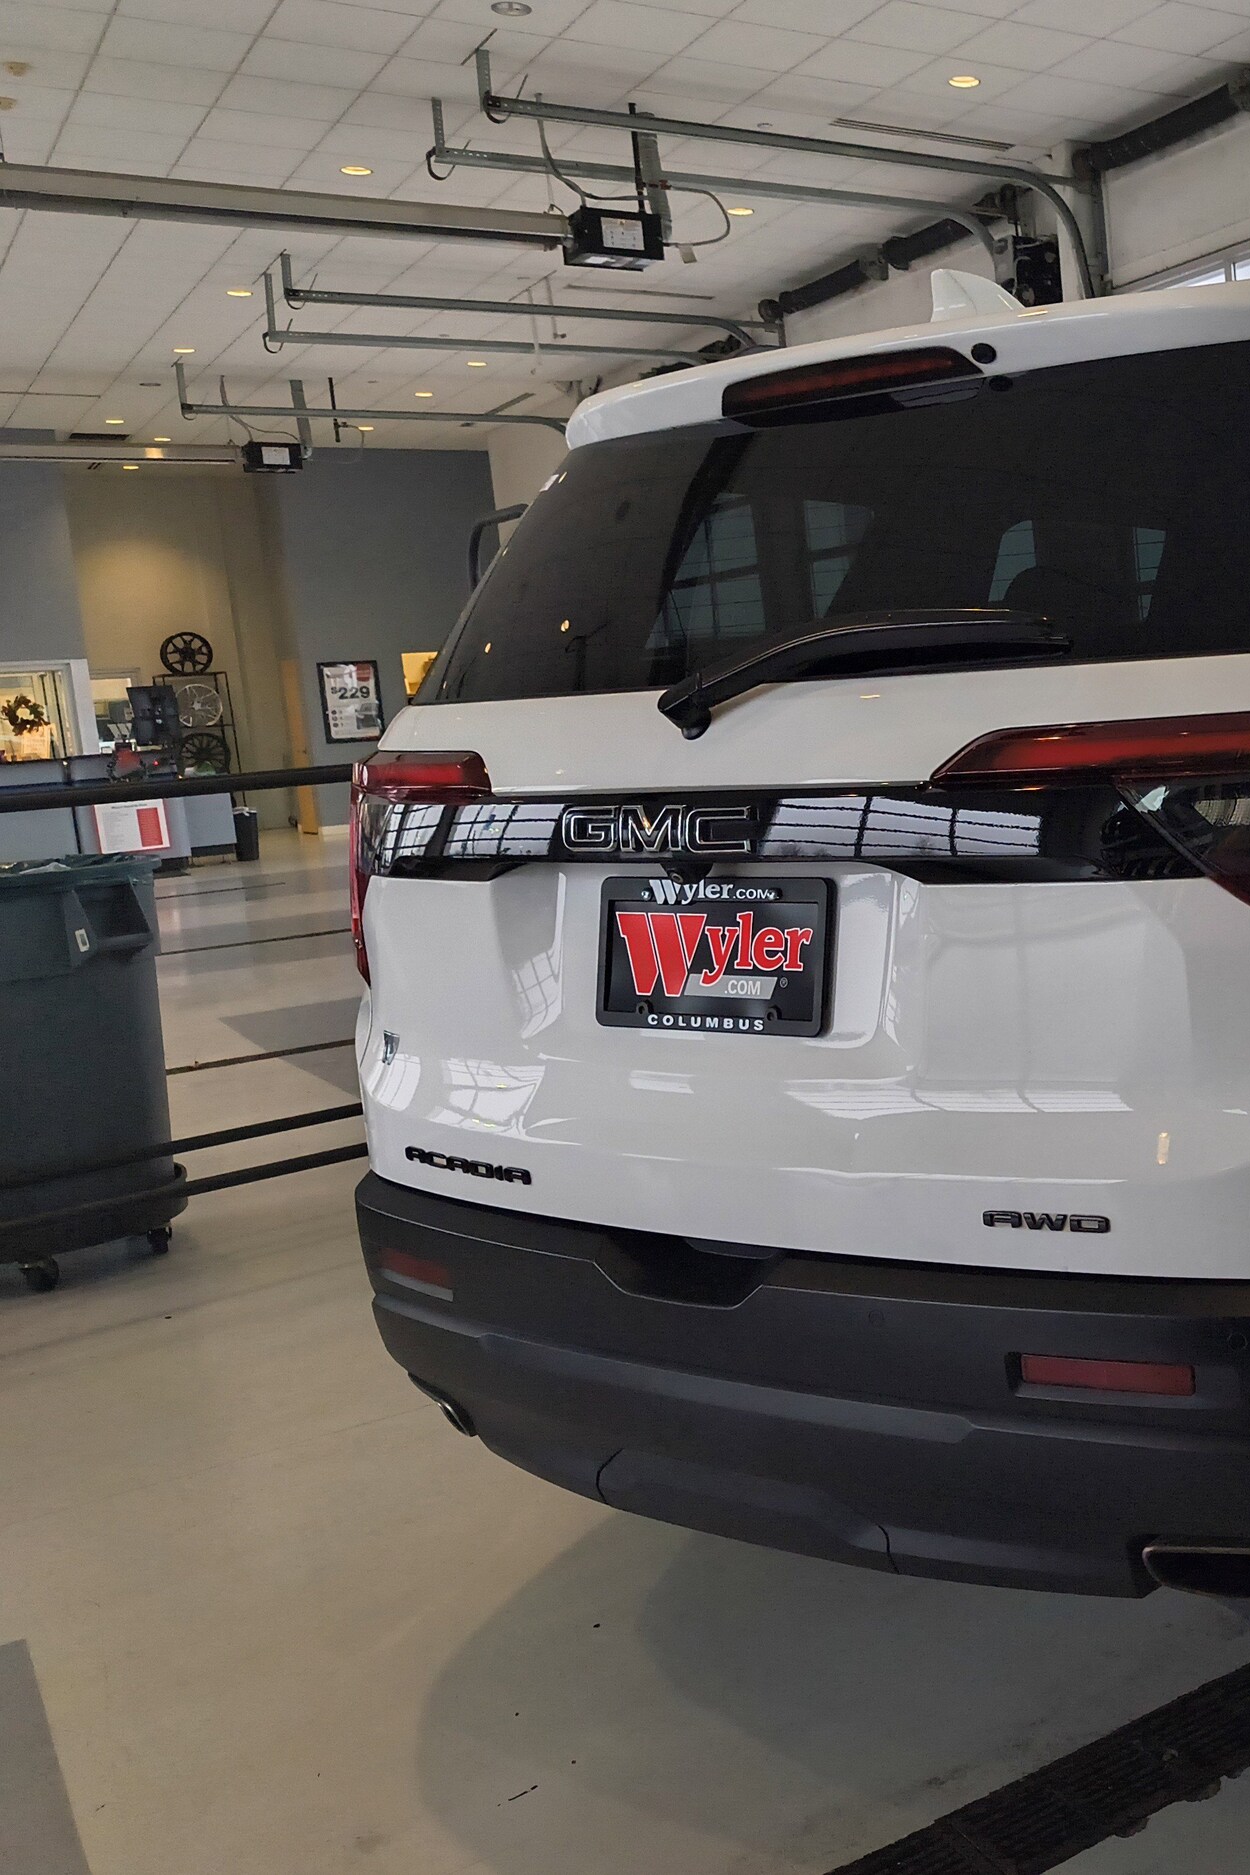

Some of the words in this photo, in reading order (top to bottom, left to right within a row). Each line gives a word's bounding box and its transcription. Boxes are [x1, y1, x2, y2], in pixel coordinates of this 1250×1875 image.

[331, 686, 371, 700] $229
[562, 804, 752, 853] GMC
[615, 911, 813, 997] Wyler
[647, 1013, 765, 1032] COLUMBUS
[405, 1146, 532, 1185] ACADIA
[983, 1210, 1111, 1234] AWD
